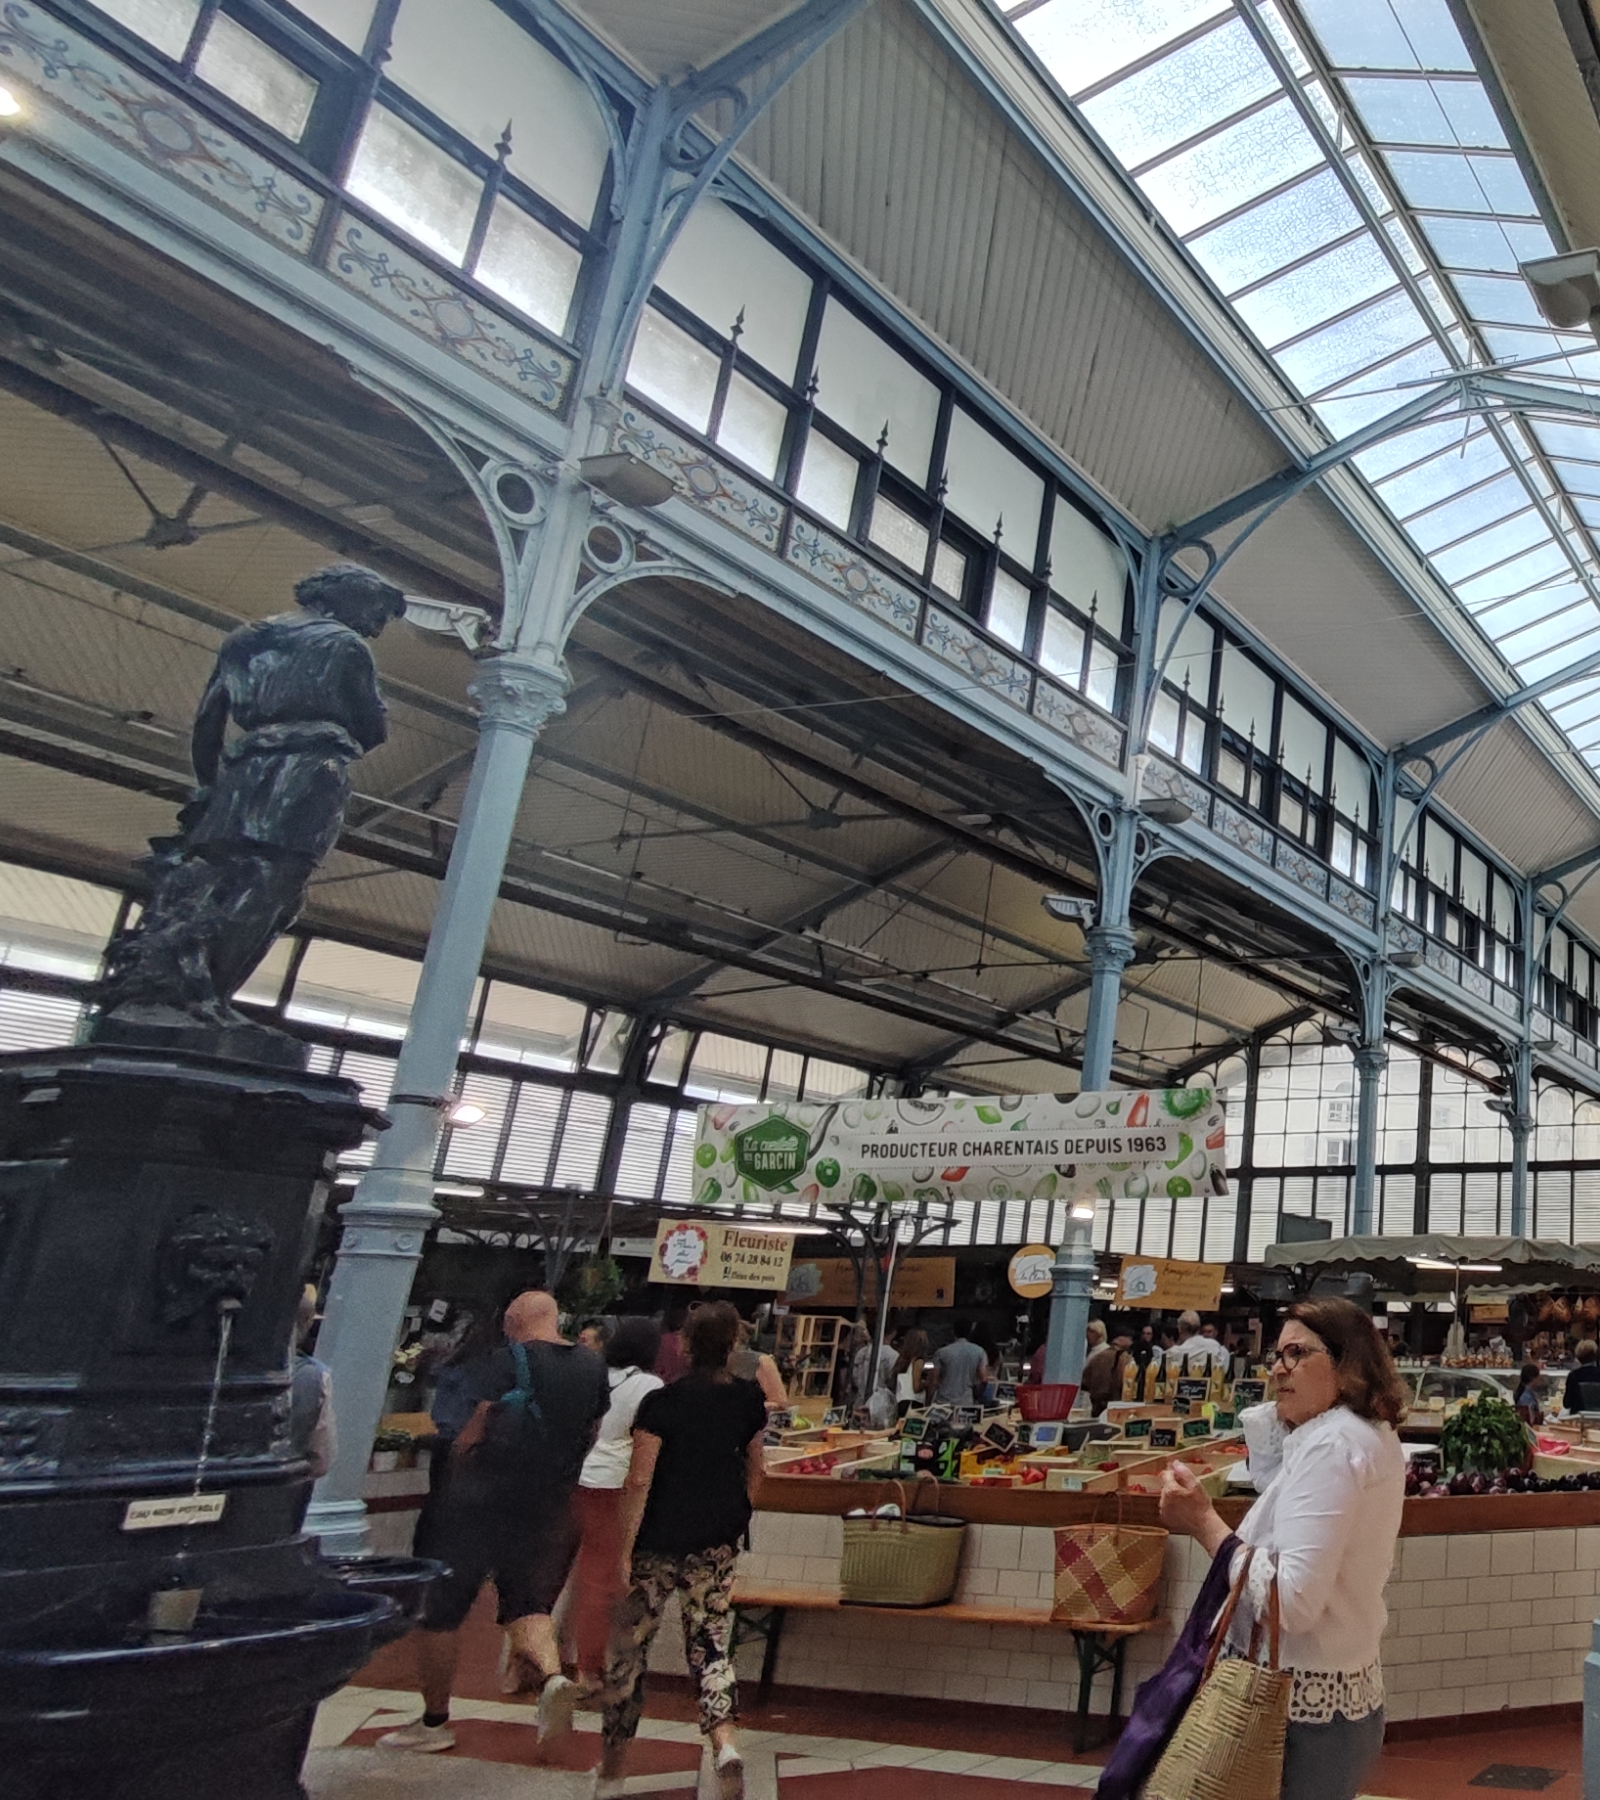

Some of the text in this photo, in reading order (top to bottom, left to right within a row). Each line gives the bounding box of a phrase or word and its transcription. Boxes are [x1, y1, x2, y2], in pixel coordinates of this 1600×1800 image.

[861, 1136, 1167, 1159] PRODUCTEUR CHARENTAIS DEPUIS 1963
[754, 1152, 797, 1171] GARCIN
[722, 1229, 788, 1252] Fleuriste
[720, 1251, 784, 1267] 06 74 28 84 12
